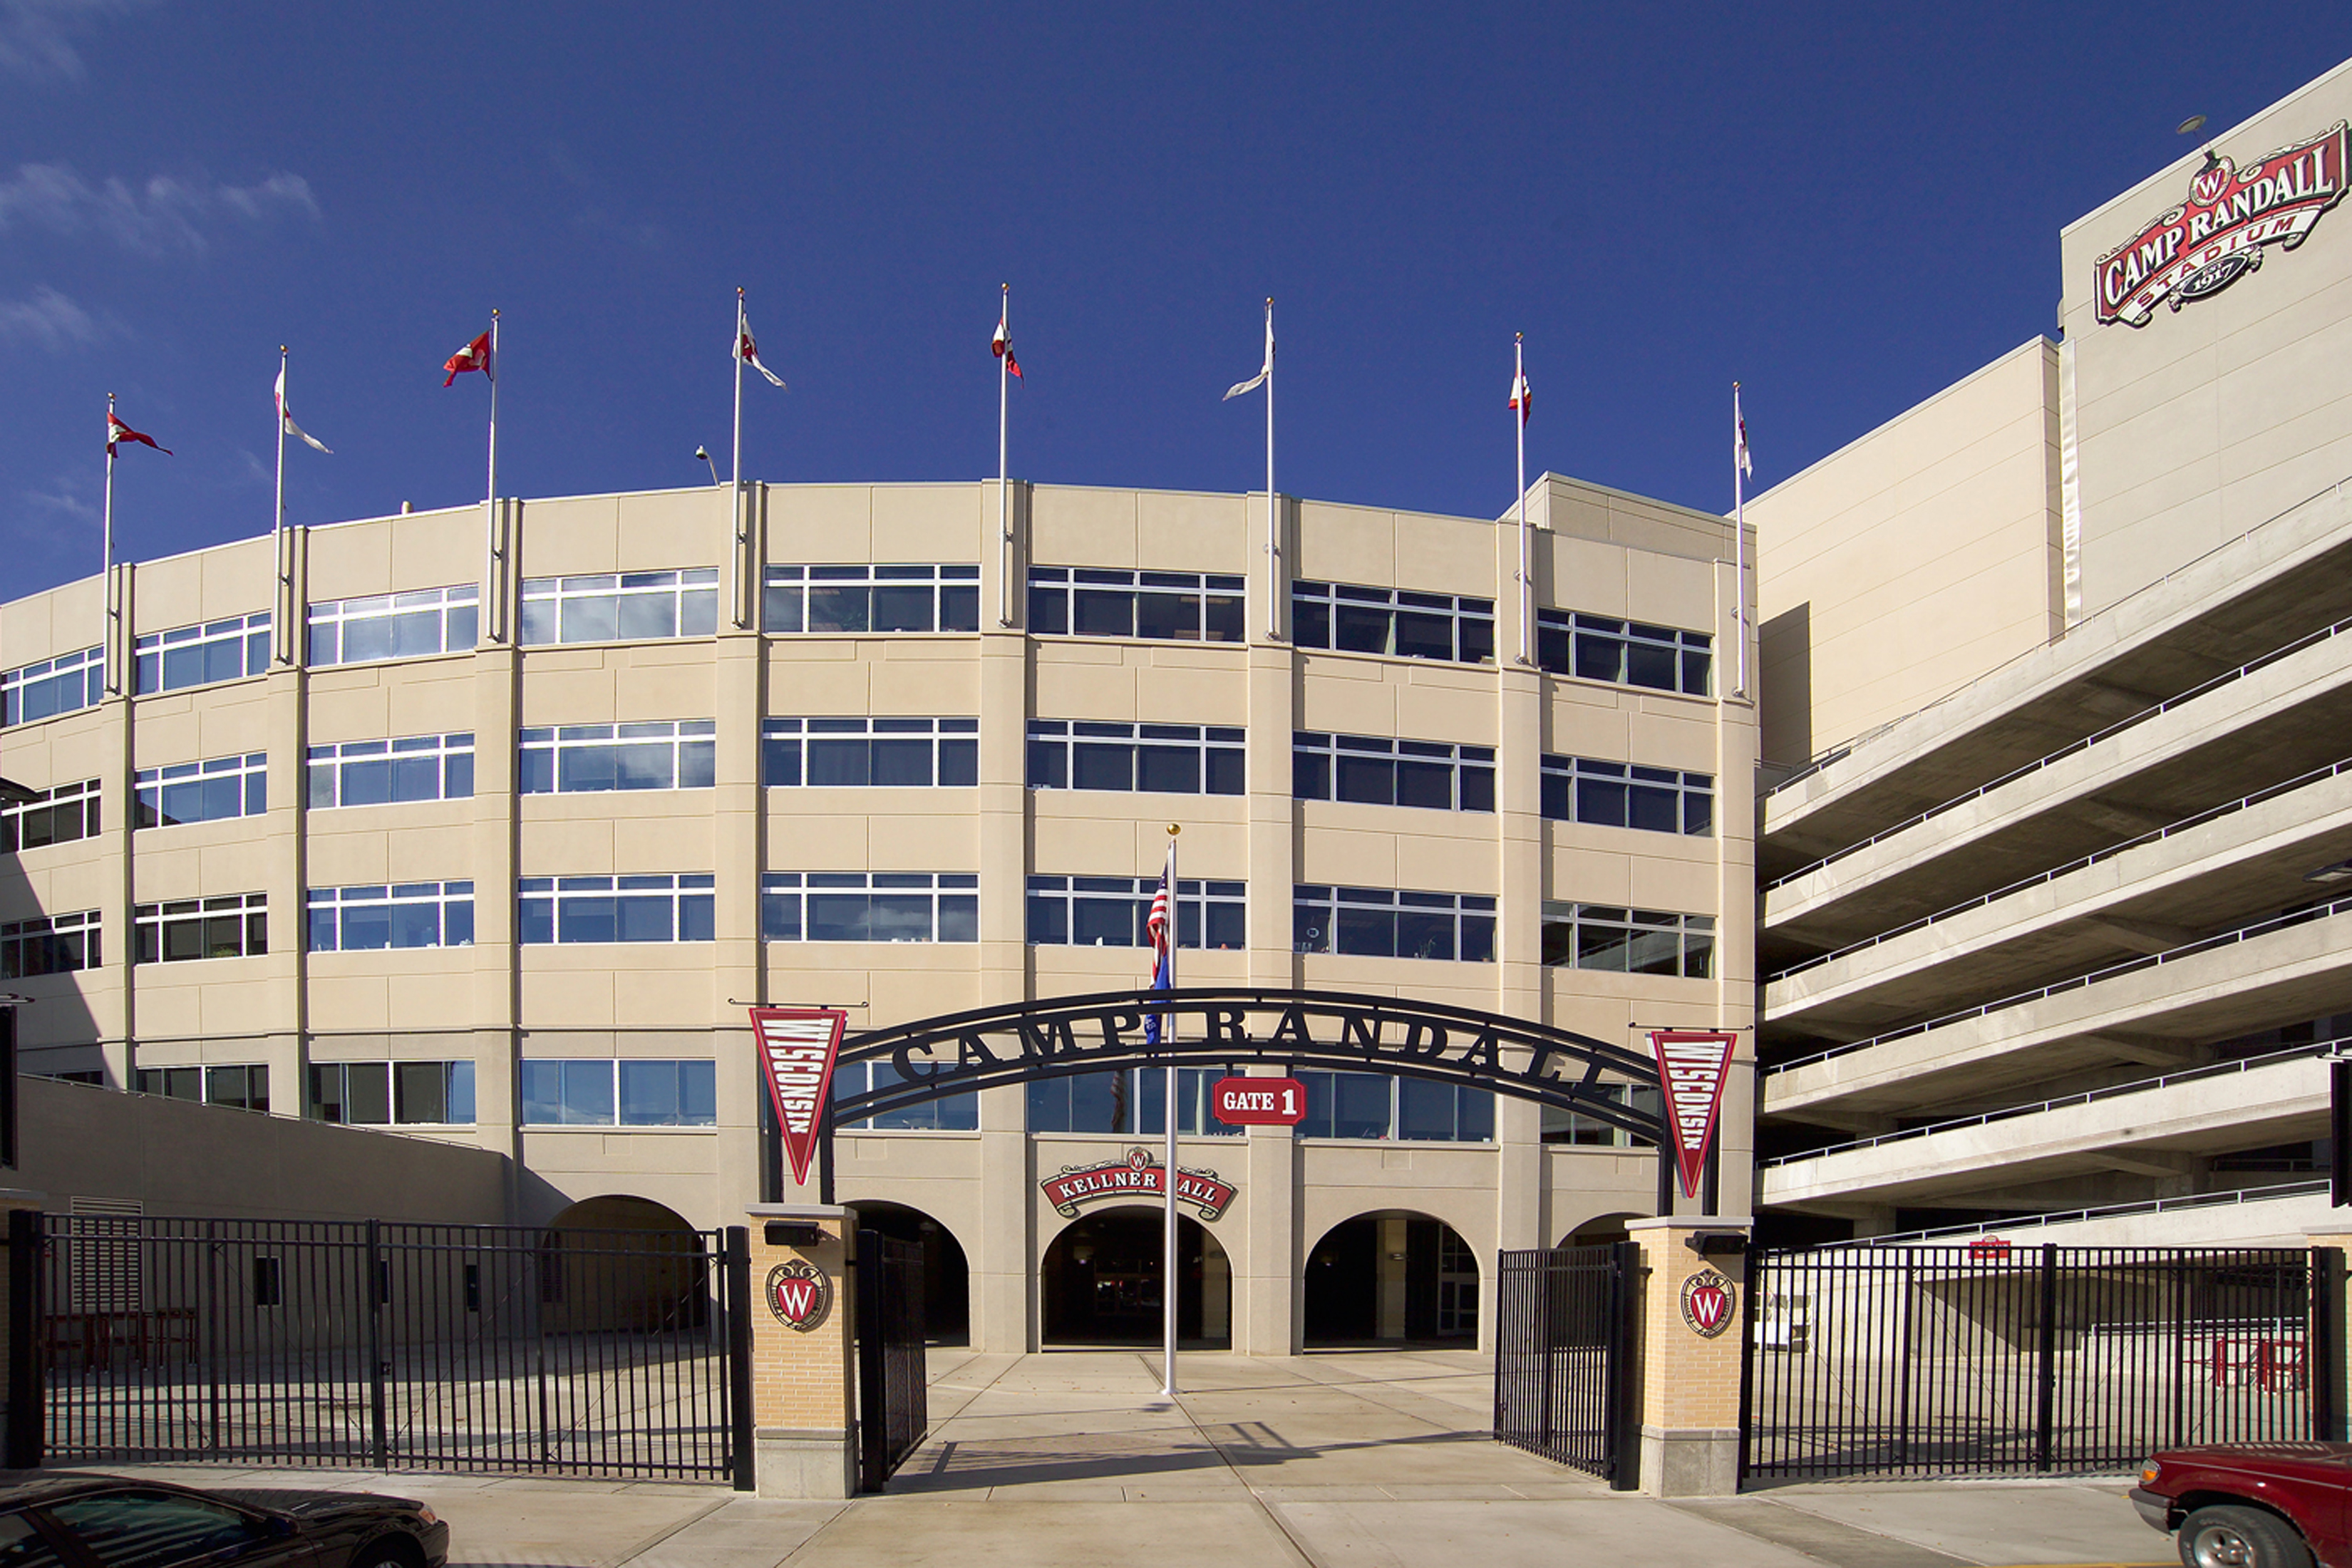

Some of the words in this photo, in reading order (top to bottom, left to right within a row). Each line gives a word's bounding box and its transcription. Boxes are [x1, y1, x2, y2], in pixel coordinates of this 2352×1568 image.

[2199, 170, 2224, 198] W
[2105, 226, 2183, 306] CAMP
[2188, 144, 2334, 247] RANDALL
[2138, 216, 2296, 307] STADIUM
[2193, 262, 2234, 292] 1917
[892, 1008, 1141, 1082] CAMP
[1203, 1009, 1611, 1100] RANDALL
[761, 1018, 835, 1134] WISCONSIN
[1223, 1091, 1274, 1110] GATE
[1281, 1089, 1297, 1115] 1
[1662, 1041, 1728, 1150] WISCONSIN
[1132, 1155, 1146, 1167] W
[1058, 1172, 1157, 1198] KELLNER
[1165, 1177, 1216, 1202] ALL
[780, 1284, 813, 1316] W
[1693, 1292, 1723, 1324] W
